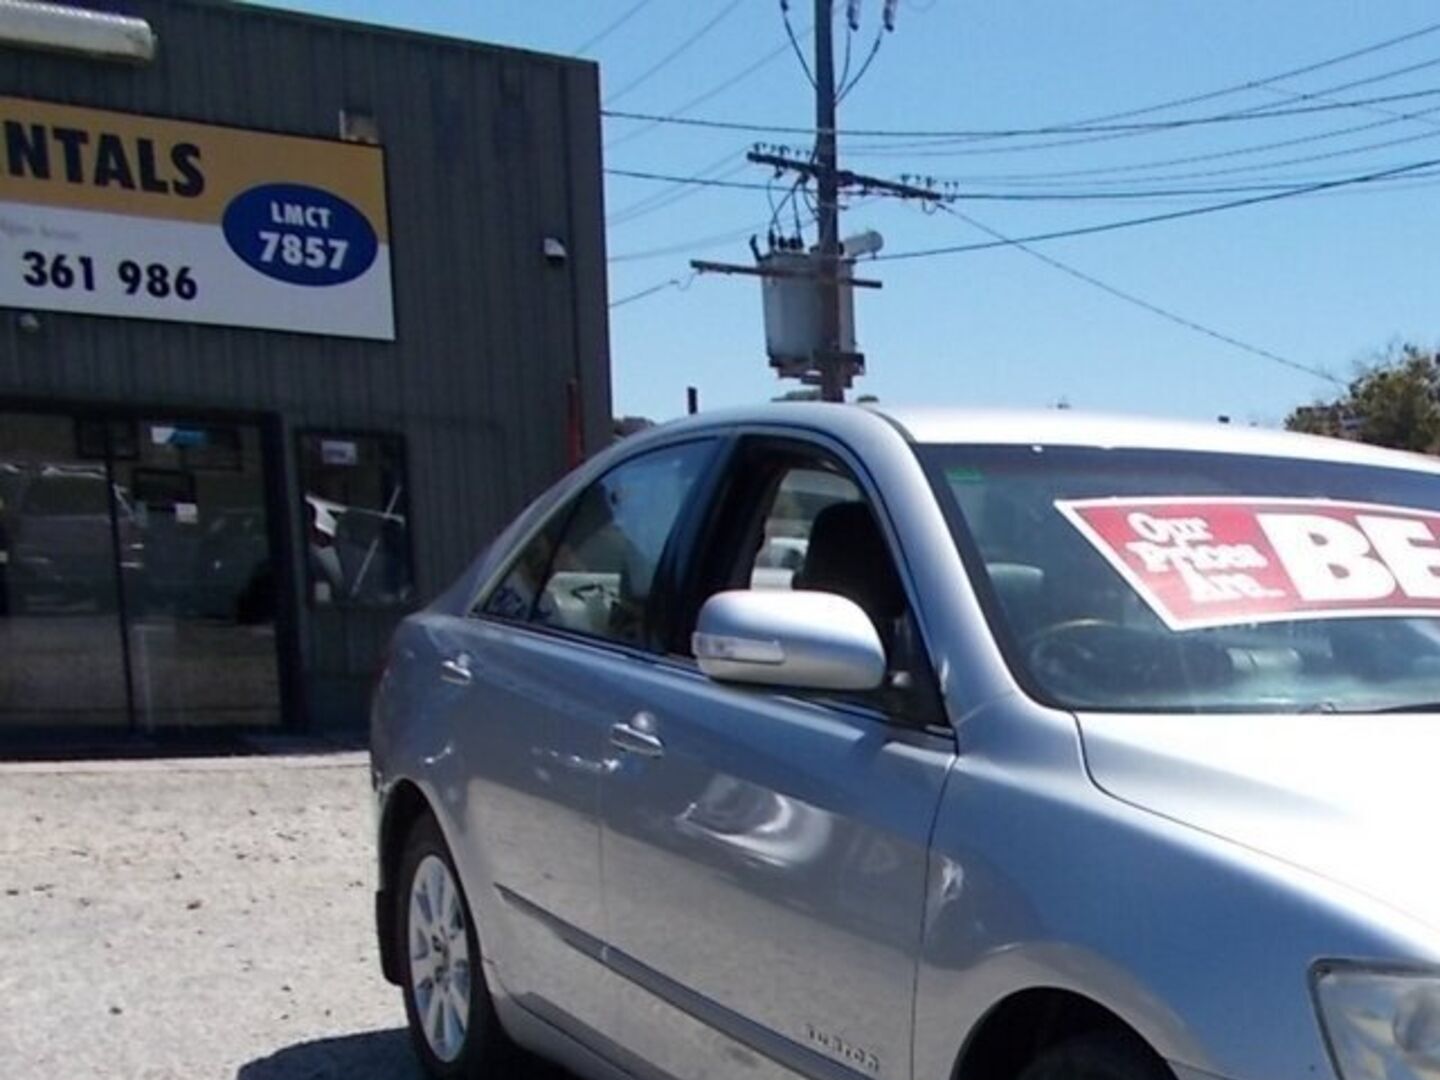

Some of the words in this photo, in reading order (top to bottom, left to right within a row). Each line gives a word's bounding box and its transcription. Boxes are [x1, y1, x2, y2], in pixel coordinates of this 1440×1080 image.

[3, 120, 206, 198] NTALS
[270, 201, 332, 229] LMCT
[258, 231, 349, 270] 7857
[22, 251, 96, 292] 361
[117, 260, 198, 301] 986
